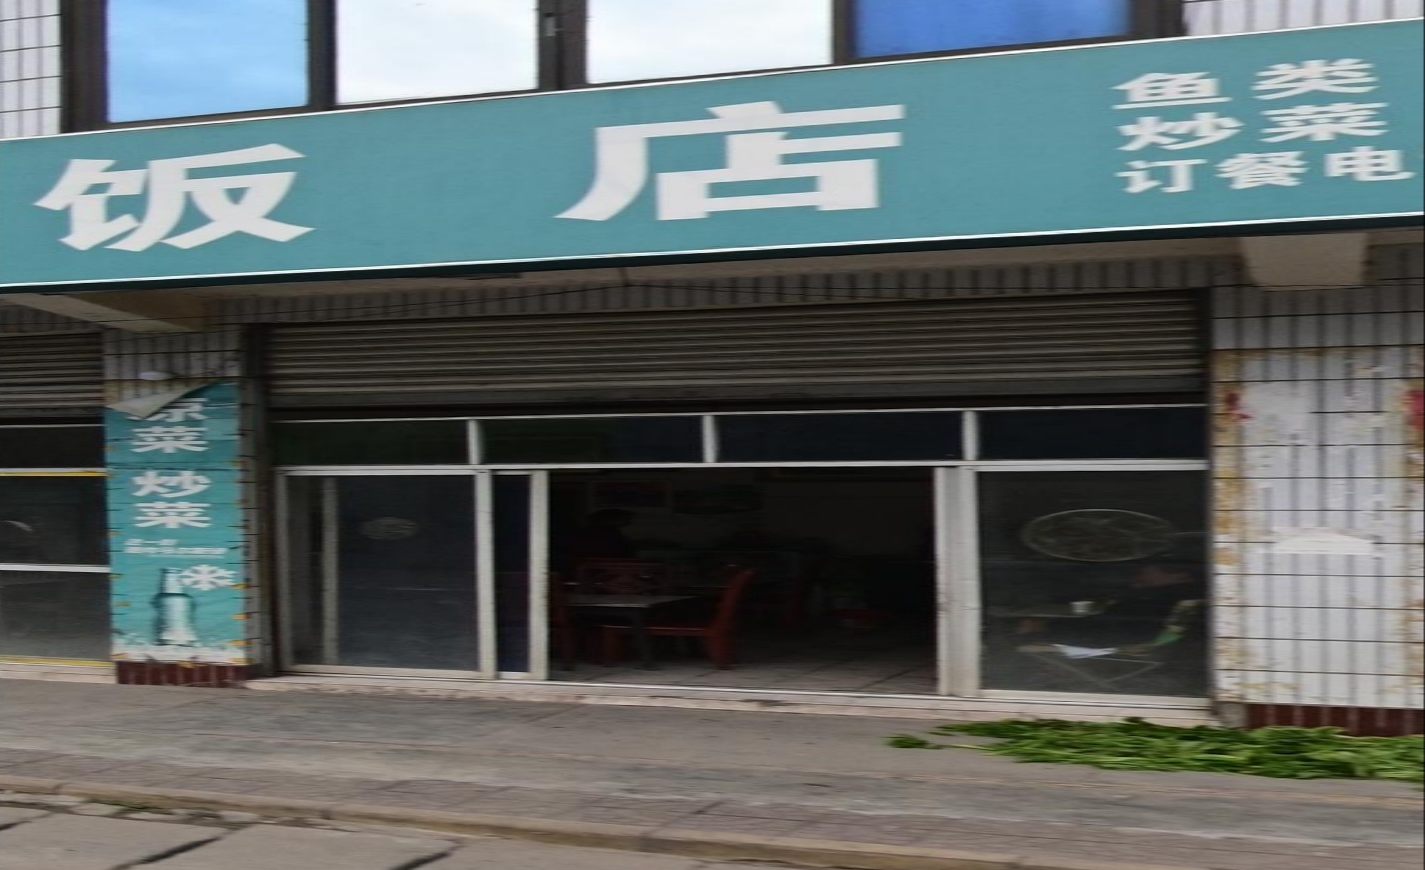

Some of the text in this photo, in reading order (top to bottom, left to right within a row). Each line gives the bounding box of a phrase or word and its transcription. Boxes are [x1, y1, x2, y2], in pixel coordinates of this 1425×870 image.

[1111, 58, 1379, 110] 鱼类
[1116, 102, 1389, 151] 炒菜
[1114, 146, 1416, 194] 订餐电
[130, 470, 212, 529] 炒菜
